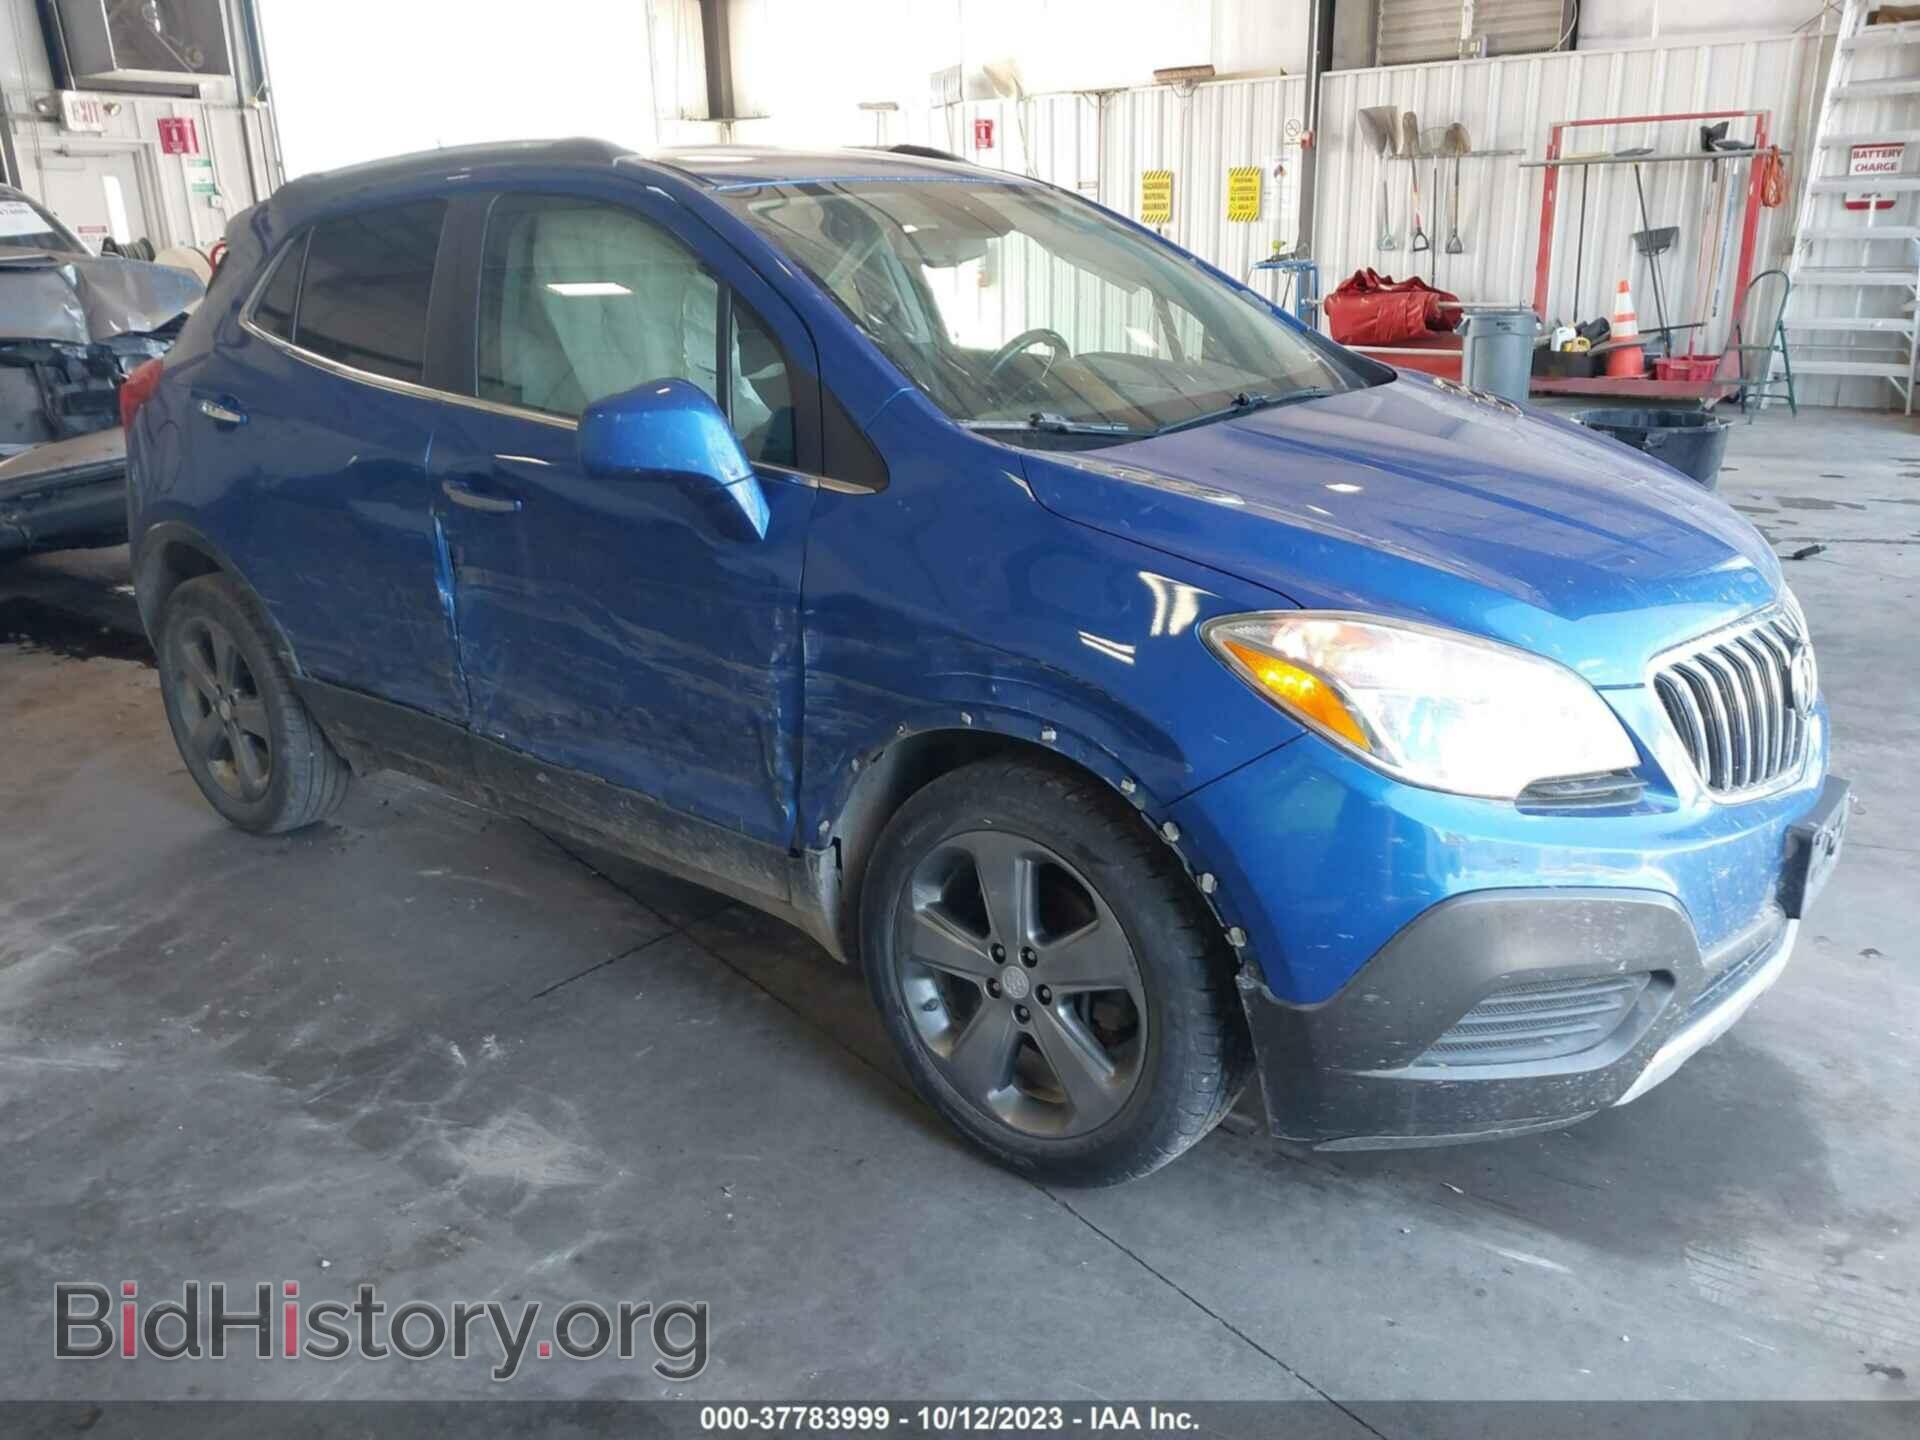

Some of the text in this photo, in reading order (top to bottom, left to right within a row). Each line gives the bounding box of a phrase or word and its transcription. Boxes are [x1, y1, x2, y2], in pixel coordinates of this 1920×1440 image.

[72, 100, 101, 123] EXIT
[1853, 148, 1903, 159] BATTERY
[1855, 162, 1897, 172] CHARGE
